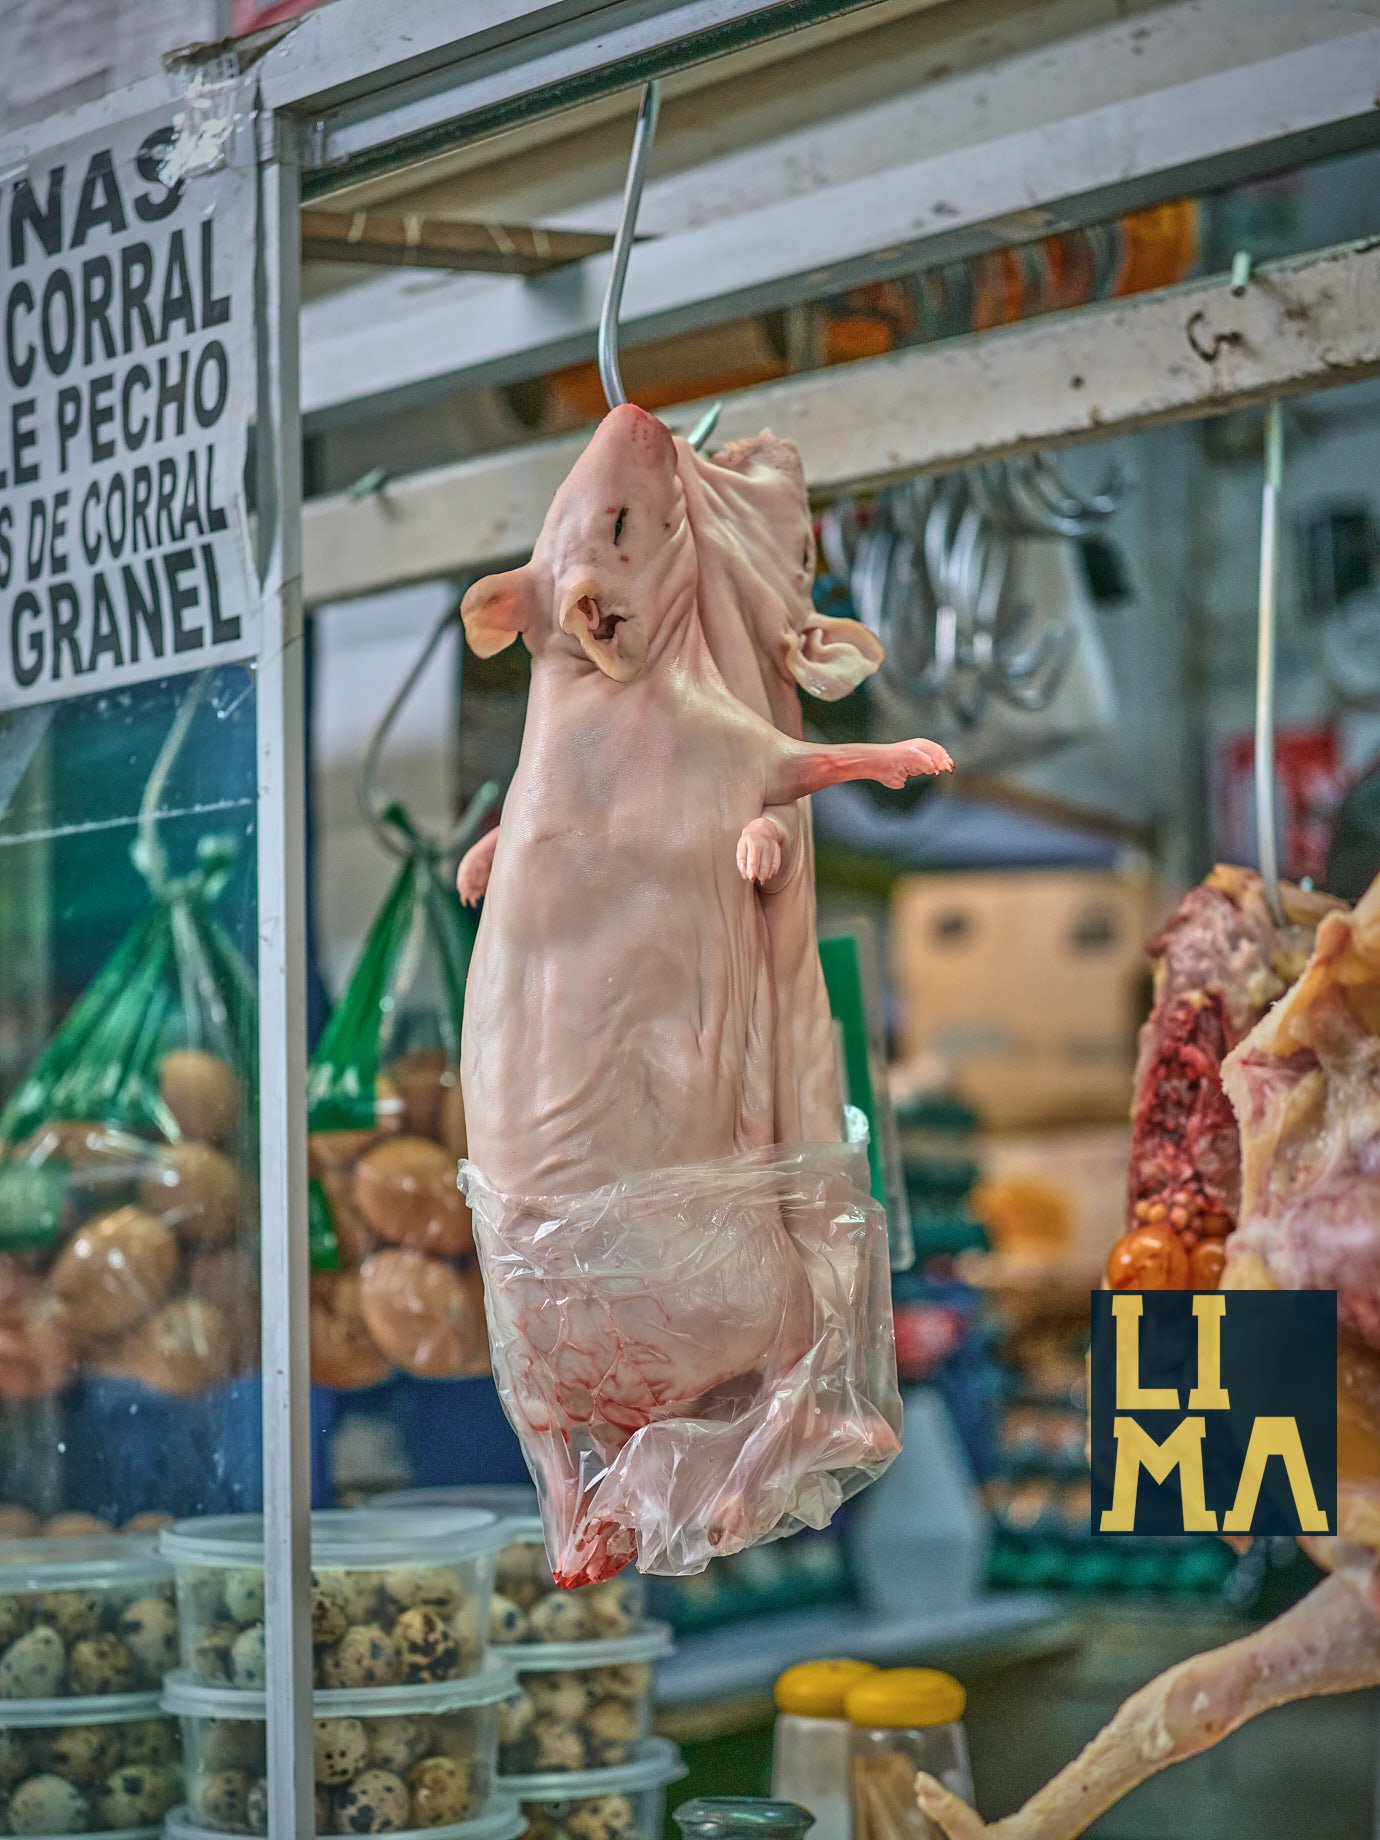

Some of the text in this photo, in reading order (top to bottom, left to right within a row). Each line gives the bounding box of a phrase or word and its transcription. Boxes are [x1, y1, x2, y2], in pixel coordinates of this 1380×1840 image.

[11, 126, 186, 270] NAS
[7, 219, 230, 388] CORRAL
[0, 340, 228, 489] E PECHO
[28, 490, 68, 581] DE
[82, 444, 228, 565] CORRAL
[11, 544, 241, 687] GRANEL
